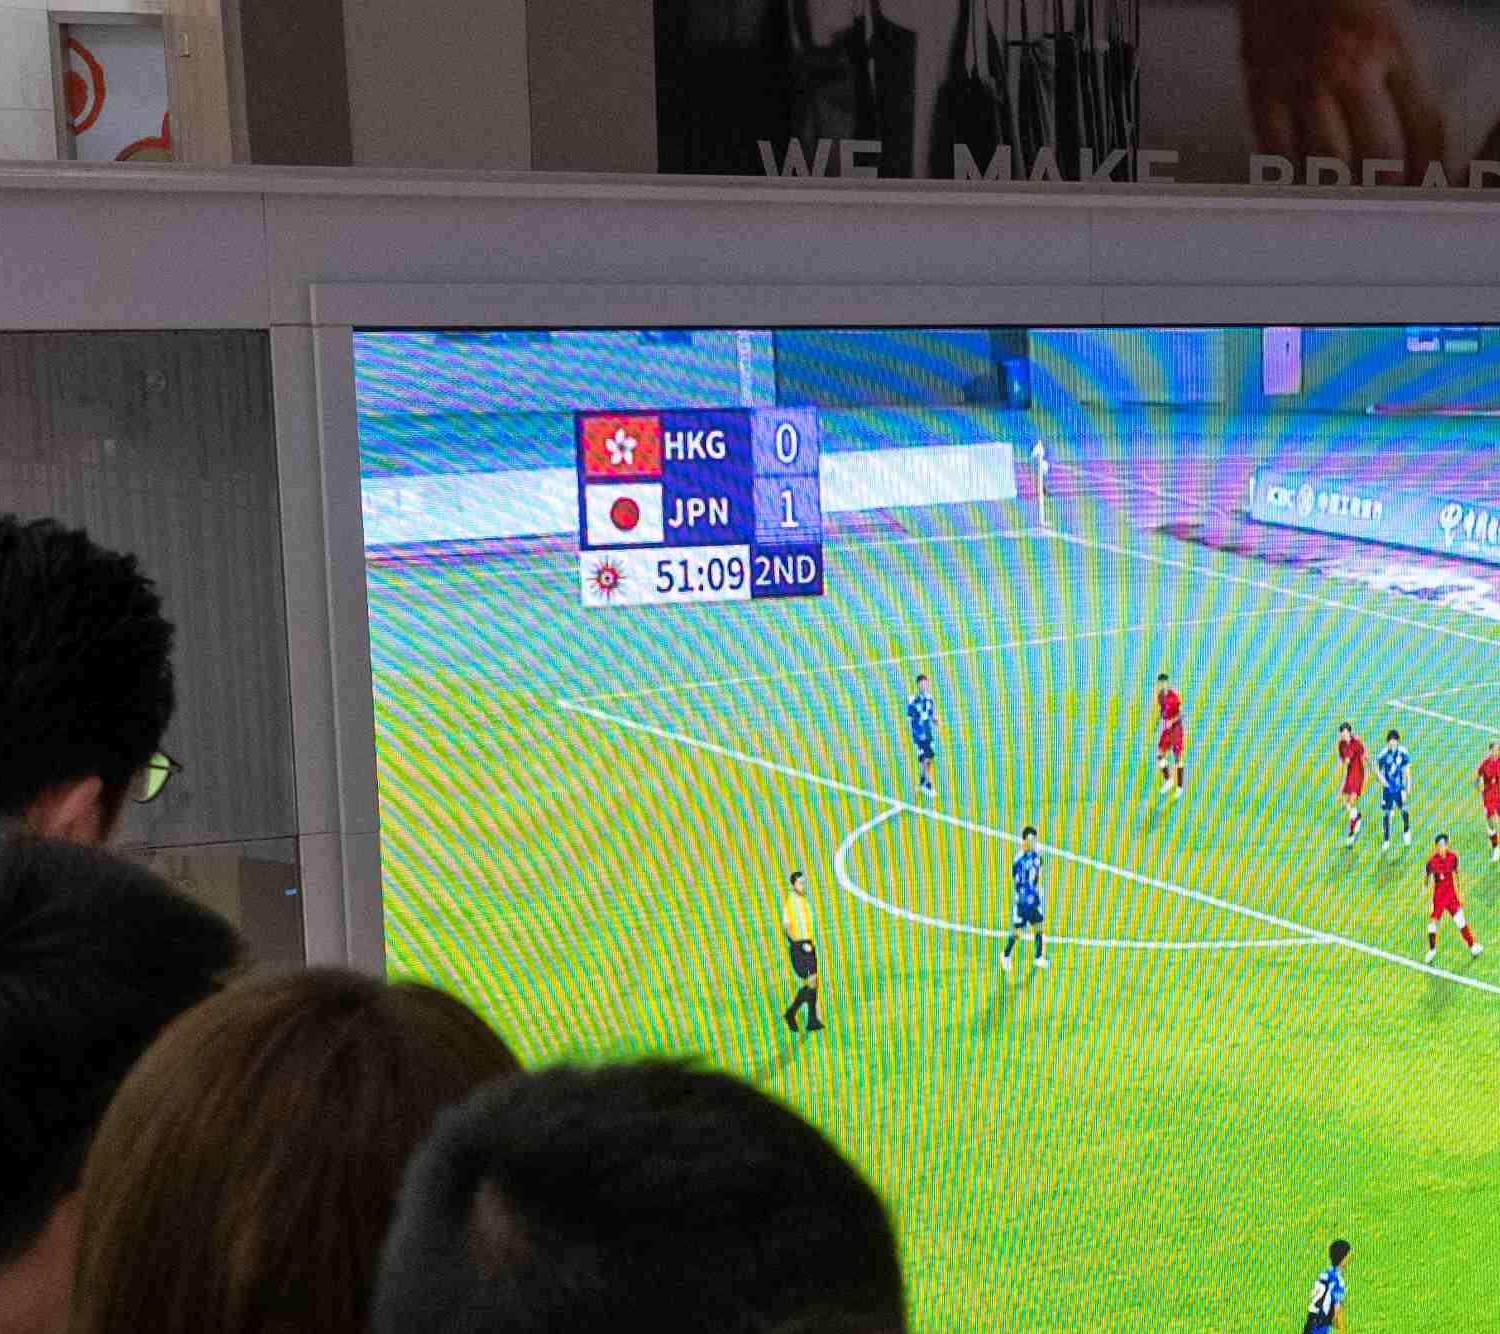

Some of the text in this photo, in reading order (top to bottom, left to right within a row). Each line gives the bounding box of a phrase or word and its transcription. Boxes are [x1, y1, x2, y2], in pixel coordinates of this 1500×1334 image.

[663, 422, 798, 464] HKG 0
[667, 489, 799, 529] JPN 1
[656, 554, 817, 593] 51:09 2ND
